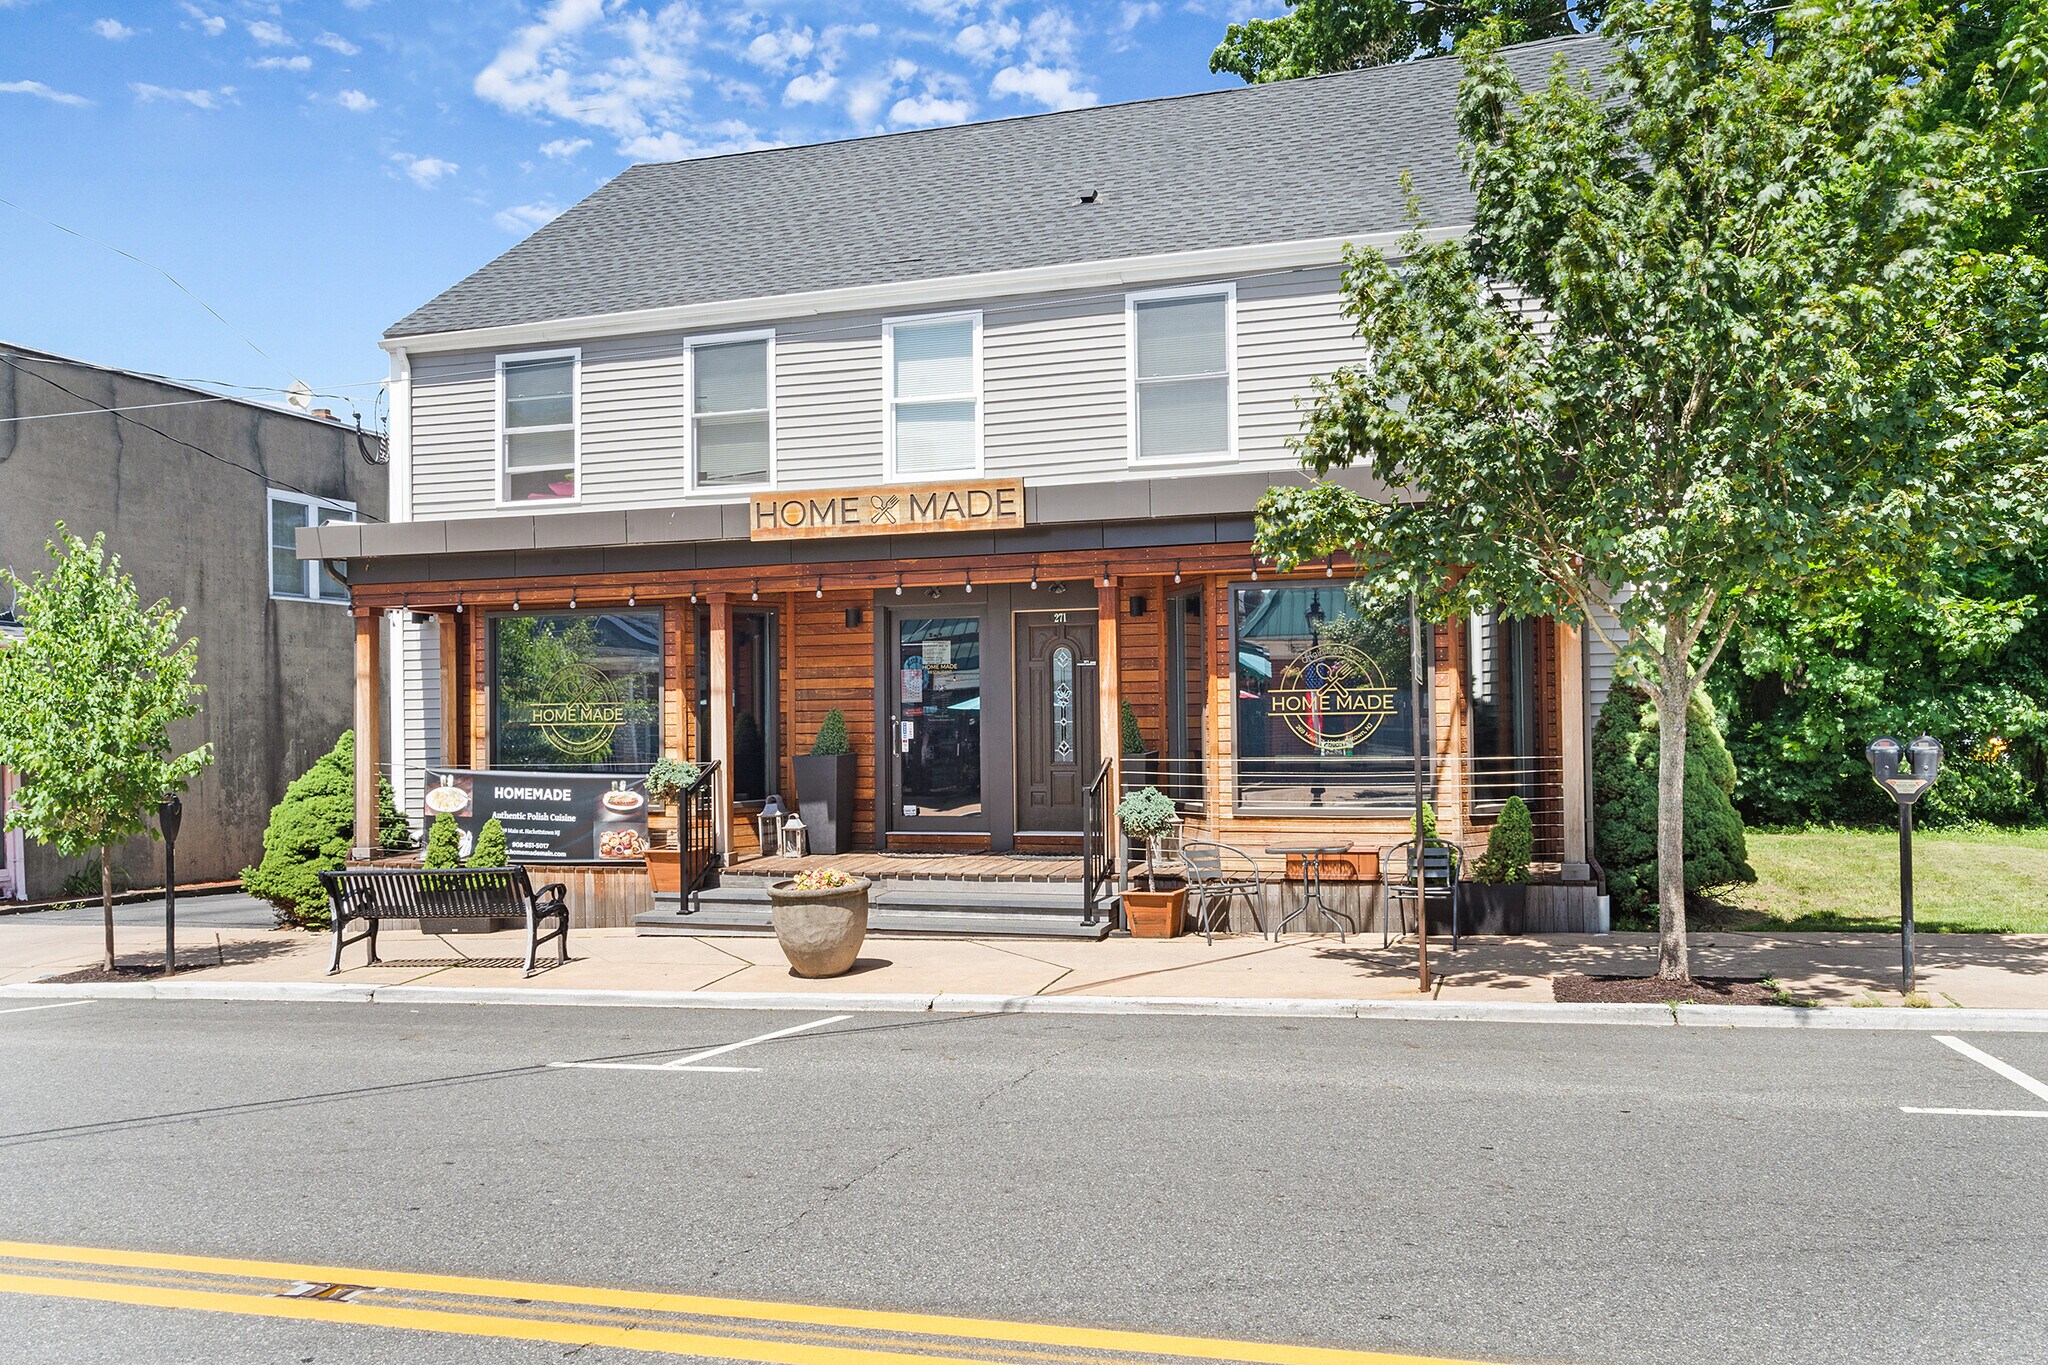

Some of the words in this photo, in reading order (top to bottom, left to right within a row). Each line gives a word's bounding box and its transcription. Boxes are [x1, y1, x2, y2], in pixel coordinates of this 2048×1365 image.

[756, 497, 860, 528] HOME
[910, 488, 1016, 521] MADE
[1054, 613, 1067, 623] 271
[1272, 695, 1330, 711] HOME
[1336, 694, 1395, 710] MADE
[533, 708, 576, 722] HOME
[581, 708, 624, 721] MADE
[494, 786, 572, 802] HOMEMADE
[491, 810, 526, 821] Authentic
[527, 812, 549, 822] Polish
[550, 813, 577, 823] Cuisine
